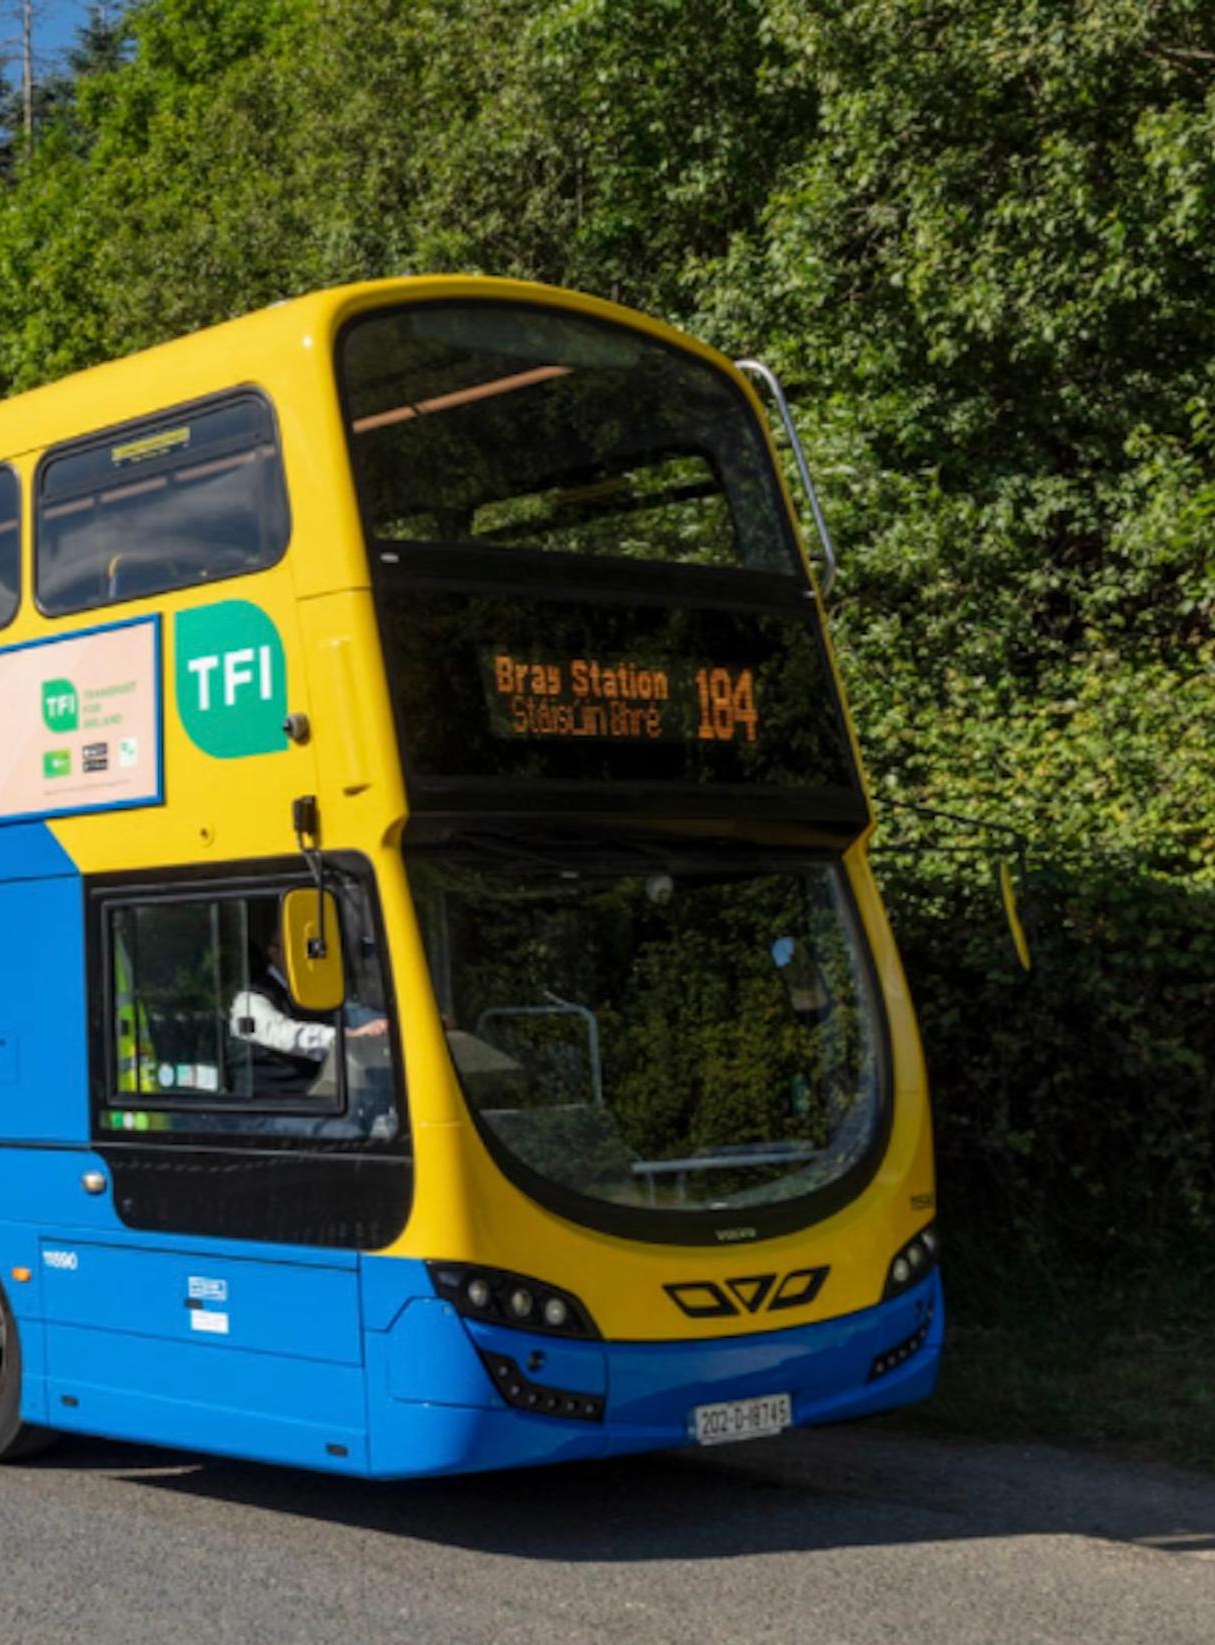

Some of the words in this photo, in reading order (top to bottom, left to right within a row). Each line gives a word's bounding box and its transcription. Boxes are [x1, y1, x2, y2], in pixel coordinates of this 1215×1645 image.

[188, 645, 272, 711] TFI
[495, 655, 561, 696] Bray
[570, 659, 669, 700] Station
[696, 667, 758, 742] 184
[46, 693, 75, 719] TFI
